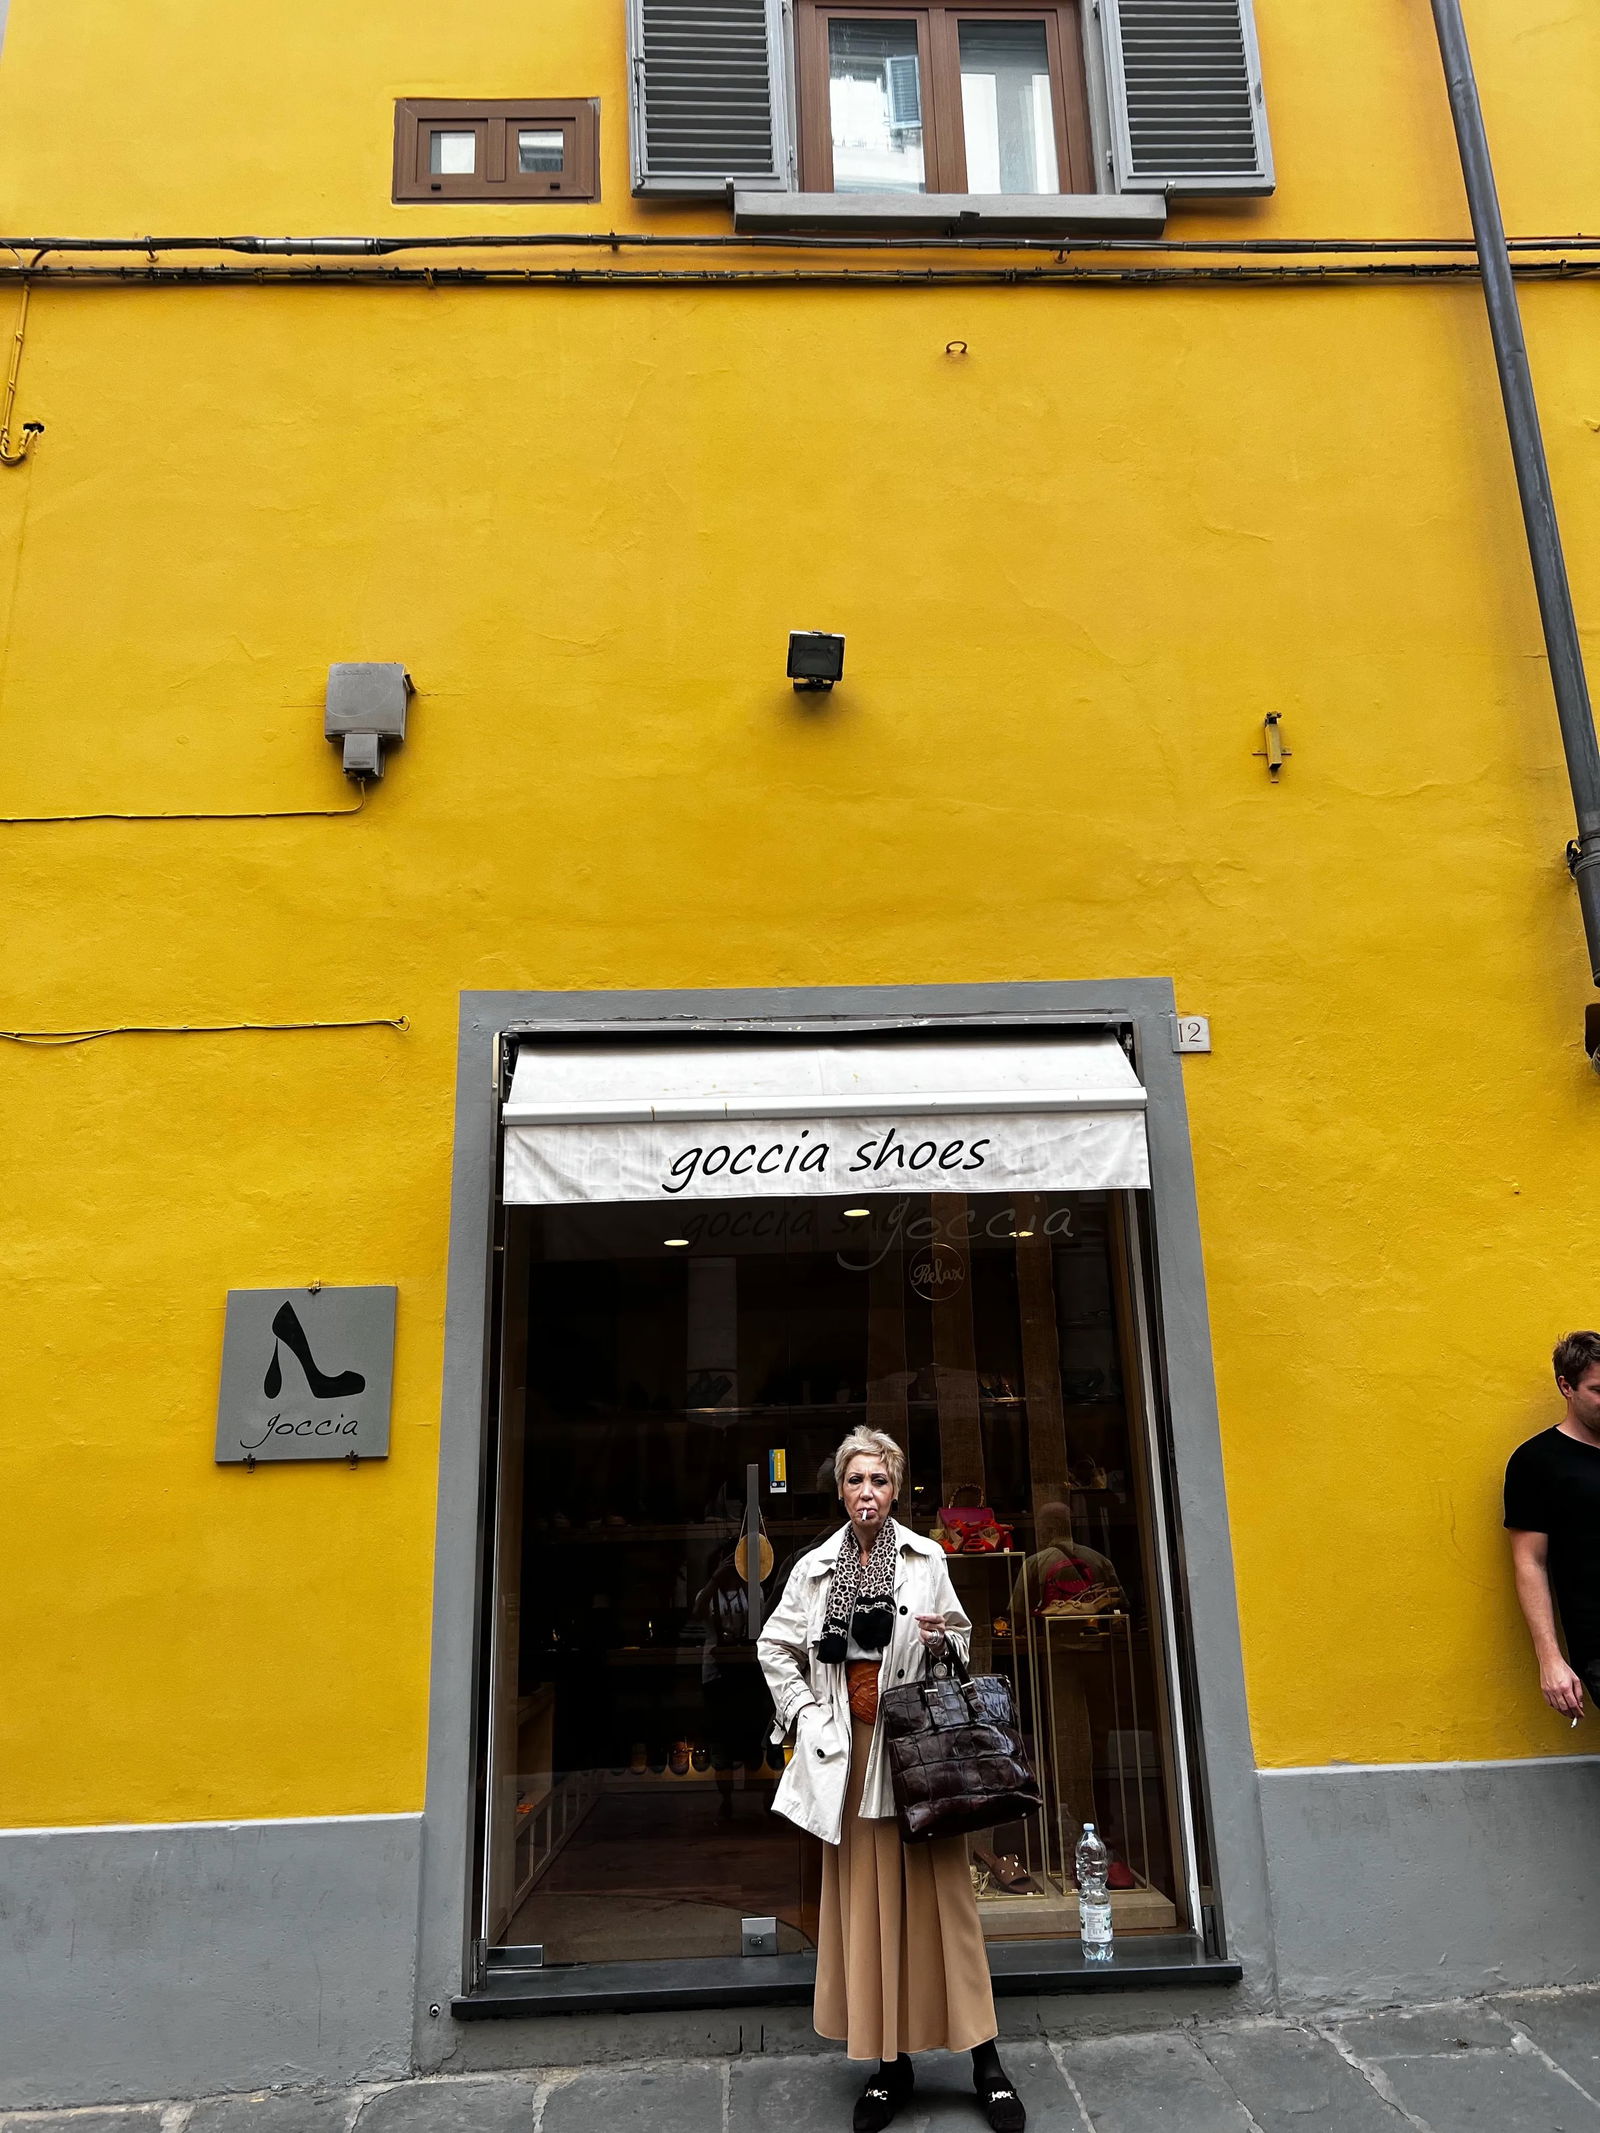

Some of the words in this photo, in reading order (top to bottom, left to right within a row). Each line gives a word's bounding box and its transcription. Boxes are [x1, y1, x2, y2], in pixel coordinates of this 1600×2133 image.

[1178, 1022, 1203, 1043] 12
[661, 1129, 830, 1194] goccia
[848, 1127, 991, 1172] shoes
[836, 1195, 1075, 1272] goccia
[910, 1257, 966, 1287] Relax
[239, 1412, 359, 1450] goccia
